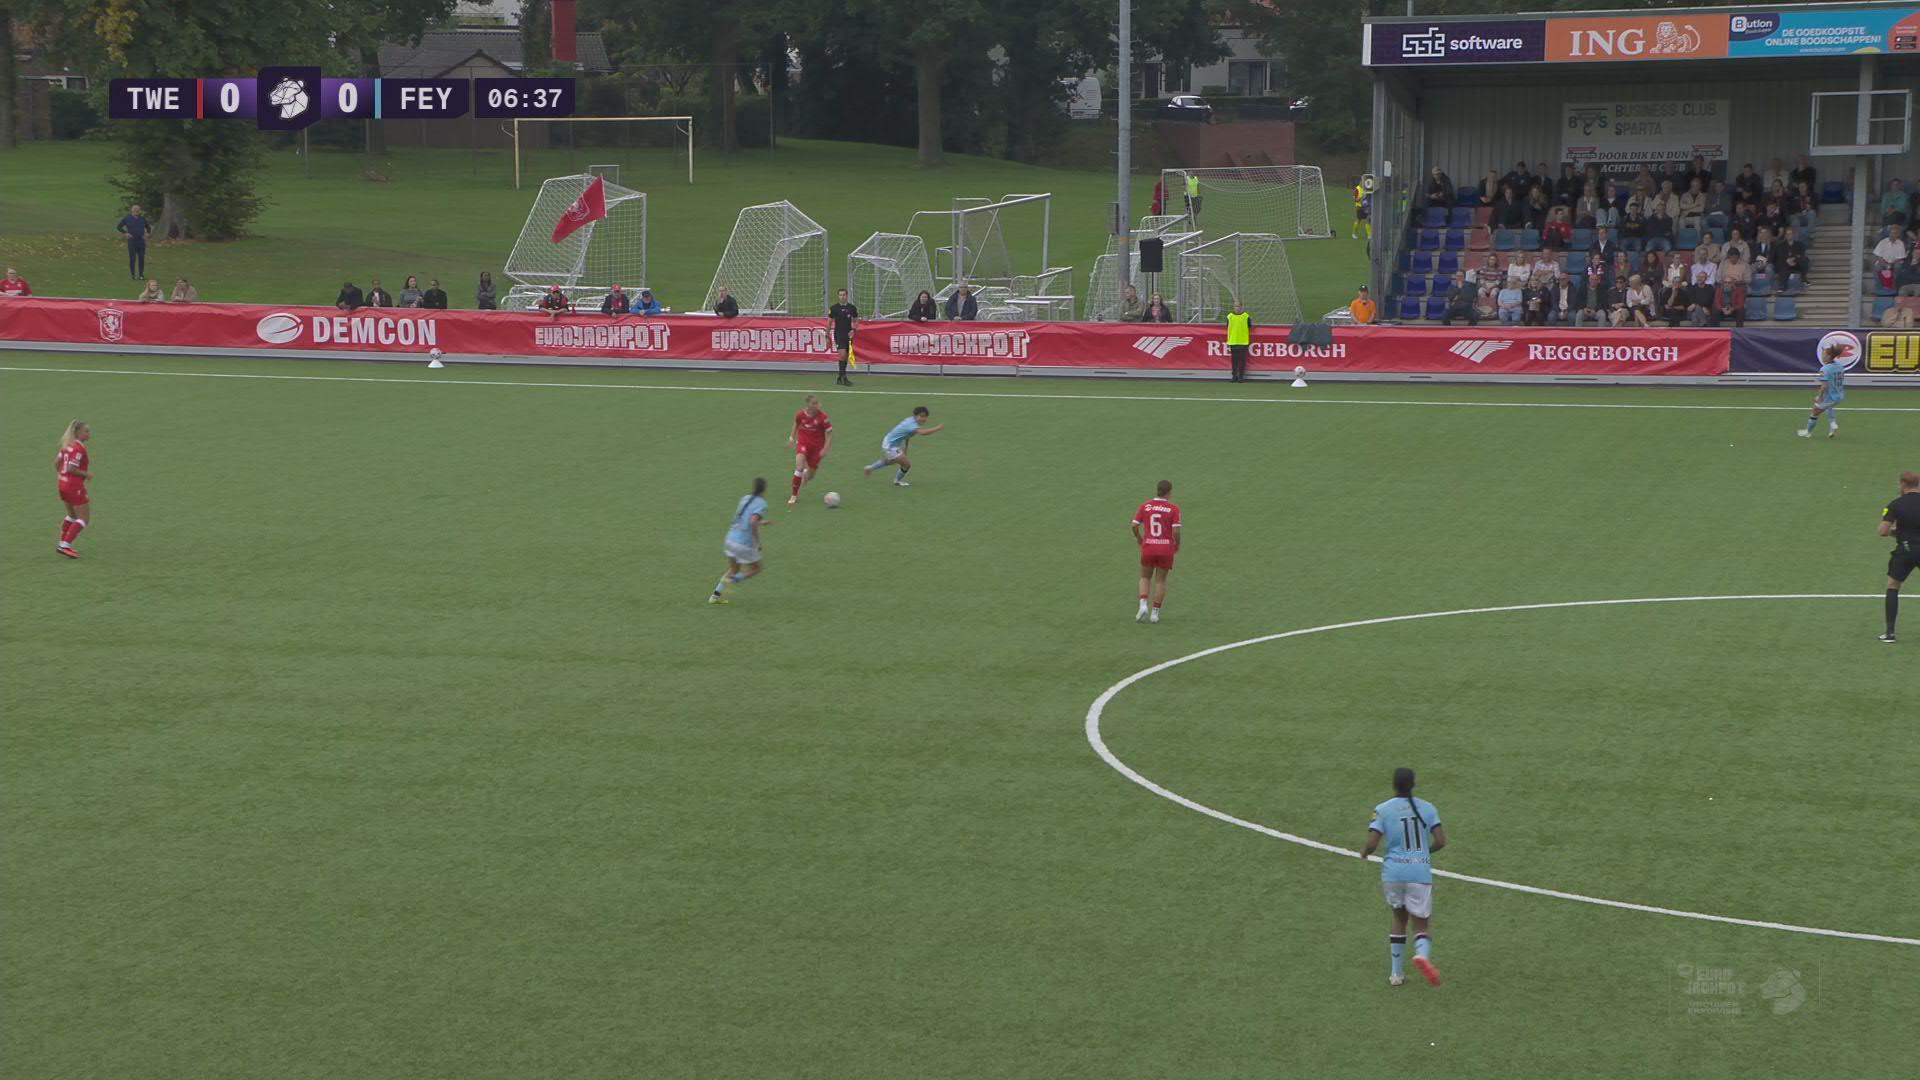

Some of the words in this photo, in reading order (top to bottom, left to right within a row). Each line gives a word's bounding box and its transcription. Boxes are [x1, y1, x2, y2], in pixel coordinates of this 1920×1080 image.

[1765, 37, 1799, 46] ONLINE
[1800, 35, 1881, 45] BOODSCHAPPEN!
[1782, 29, 1795, 37] DE
[1796, 26, 1866, 36] GOEDKOOPSTE
[1450, 35, 1523, 50] software
[1569, 29, 1646, 56] ING
[1615, 104, 1678, 117] BUSINESS
[1682, 103, 1717, 116] CLUB
[1615, 122, 1662, 136] SPARTA
[1598, 152, 1627, 160] DOOR
[1630, 152, 1649, 160] DIK
[1650, 151, 1665, 159] EN
[1666, 151, 1689, 159] DUN
[312, 316, 436, 345] DEMCON
[535, 323, 669, 350] EUROJACKPOT
[711, 328, 837, 353] EUROJACKPO
[890, 330, 1029, 357] EUROJACKPOT
[1528, 343, 1679, 361] REGGEBORGH
[1150, 514, 1162, 537] 6
[1401, 816, 1422, 851] 11
